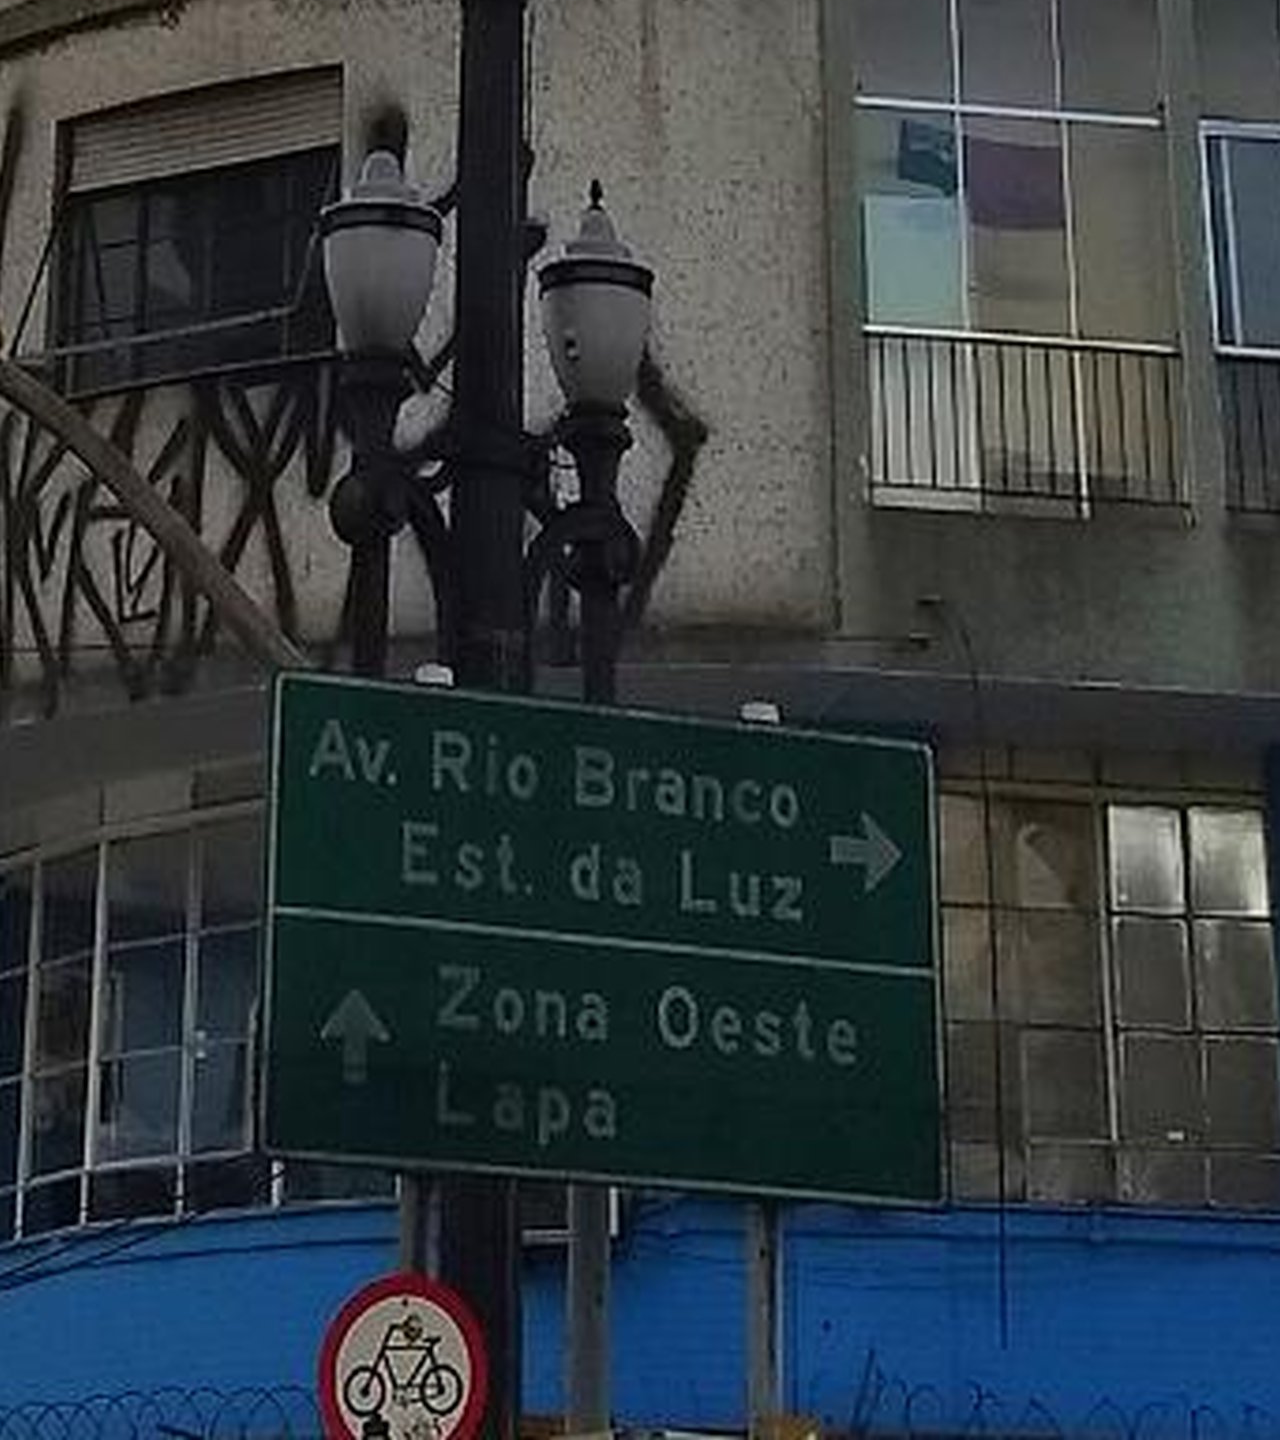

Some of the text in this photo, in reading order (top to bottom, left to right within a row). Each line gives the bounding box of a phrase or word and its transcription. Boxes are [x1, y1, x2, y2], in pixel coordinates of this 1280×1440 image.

[308, 717, 801, 829] Av. Rio Branco
[399, 819, 806, 923] Est. da Luz
[435, 963, 860, 1066] Zona Oeste
[435, 1059, 619, 1145] Lapa
